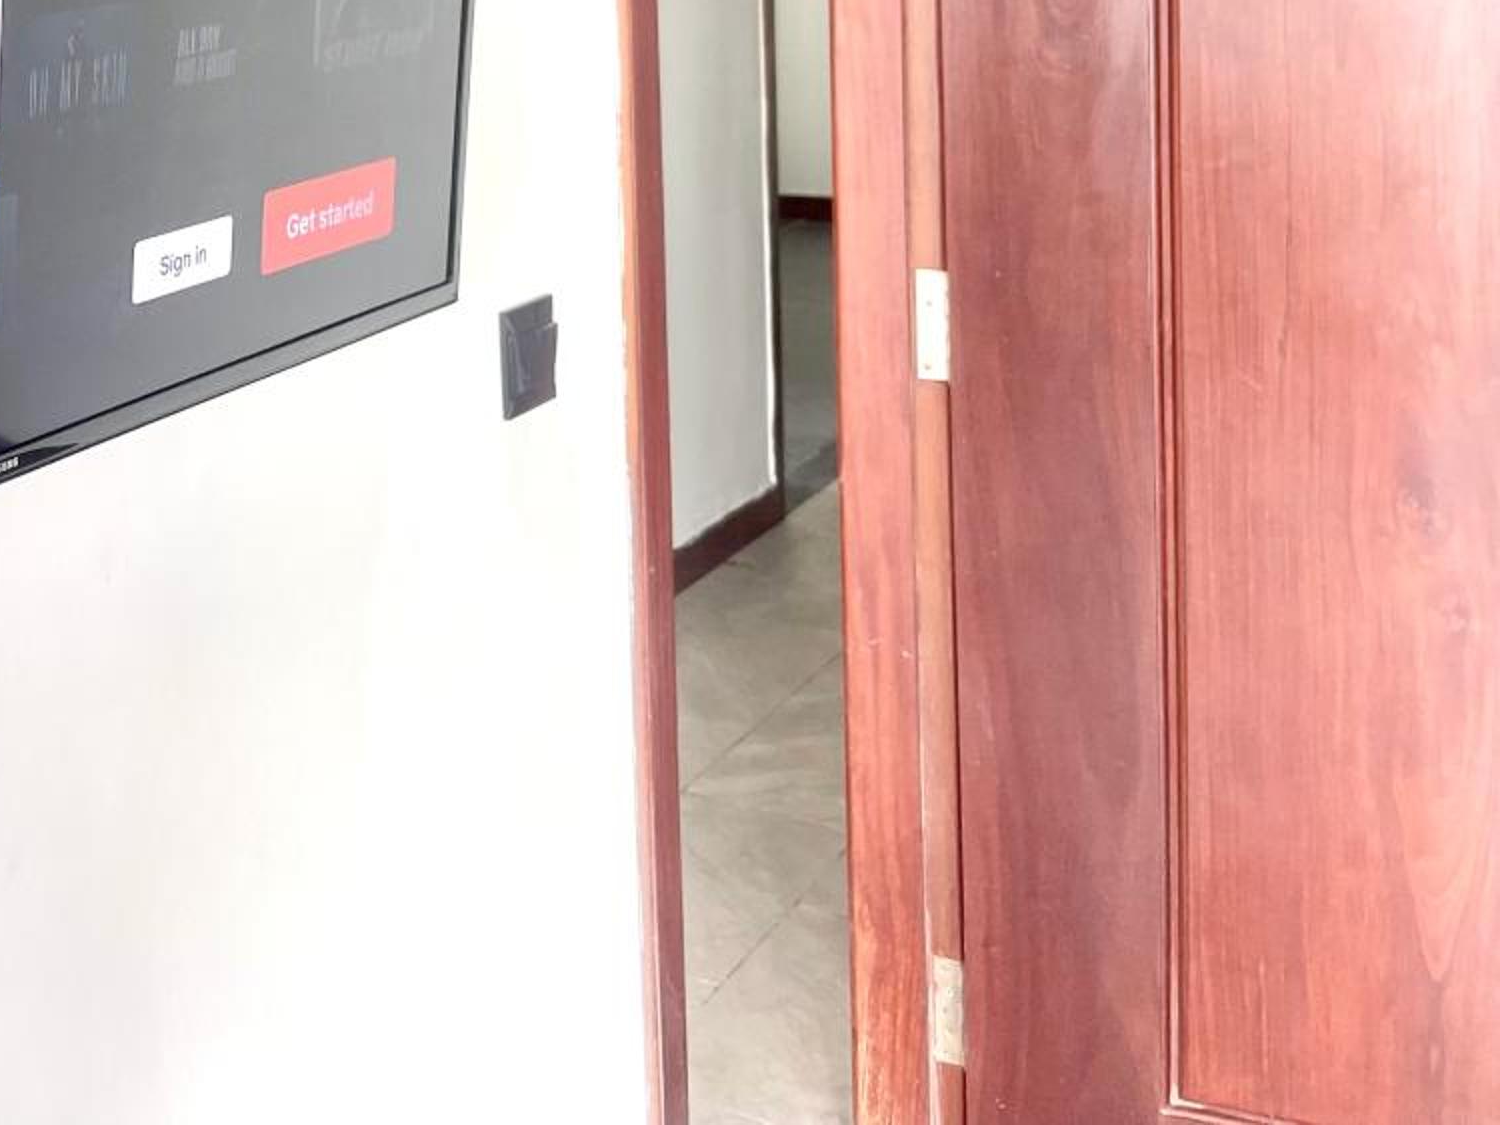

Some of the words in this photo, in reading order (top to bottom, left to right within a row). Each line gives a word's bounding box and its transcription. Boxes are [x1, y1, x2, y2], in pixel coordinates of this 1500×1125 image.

[286, 211, 316, 239] Get
[318, 189, 376, 232] started
[159, 251, 192, 277] Sign
[194, 245, 208, 265] in
